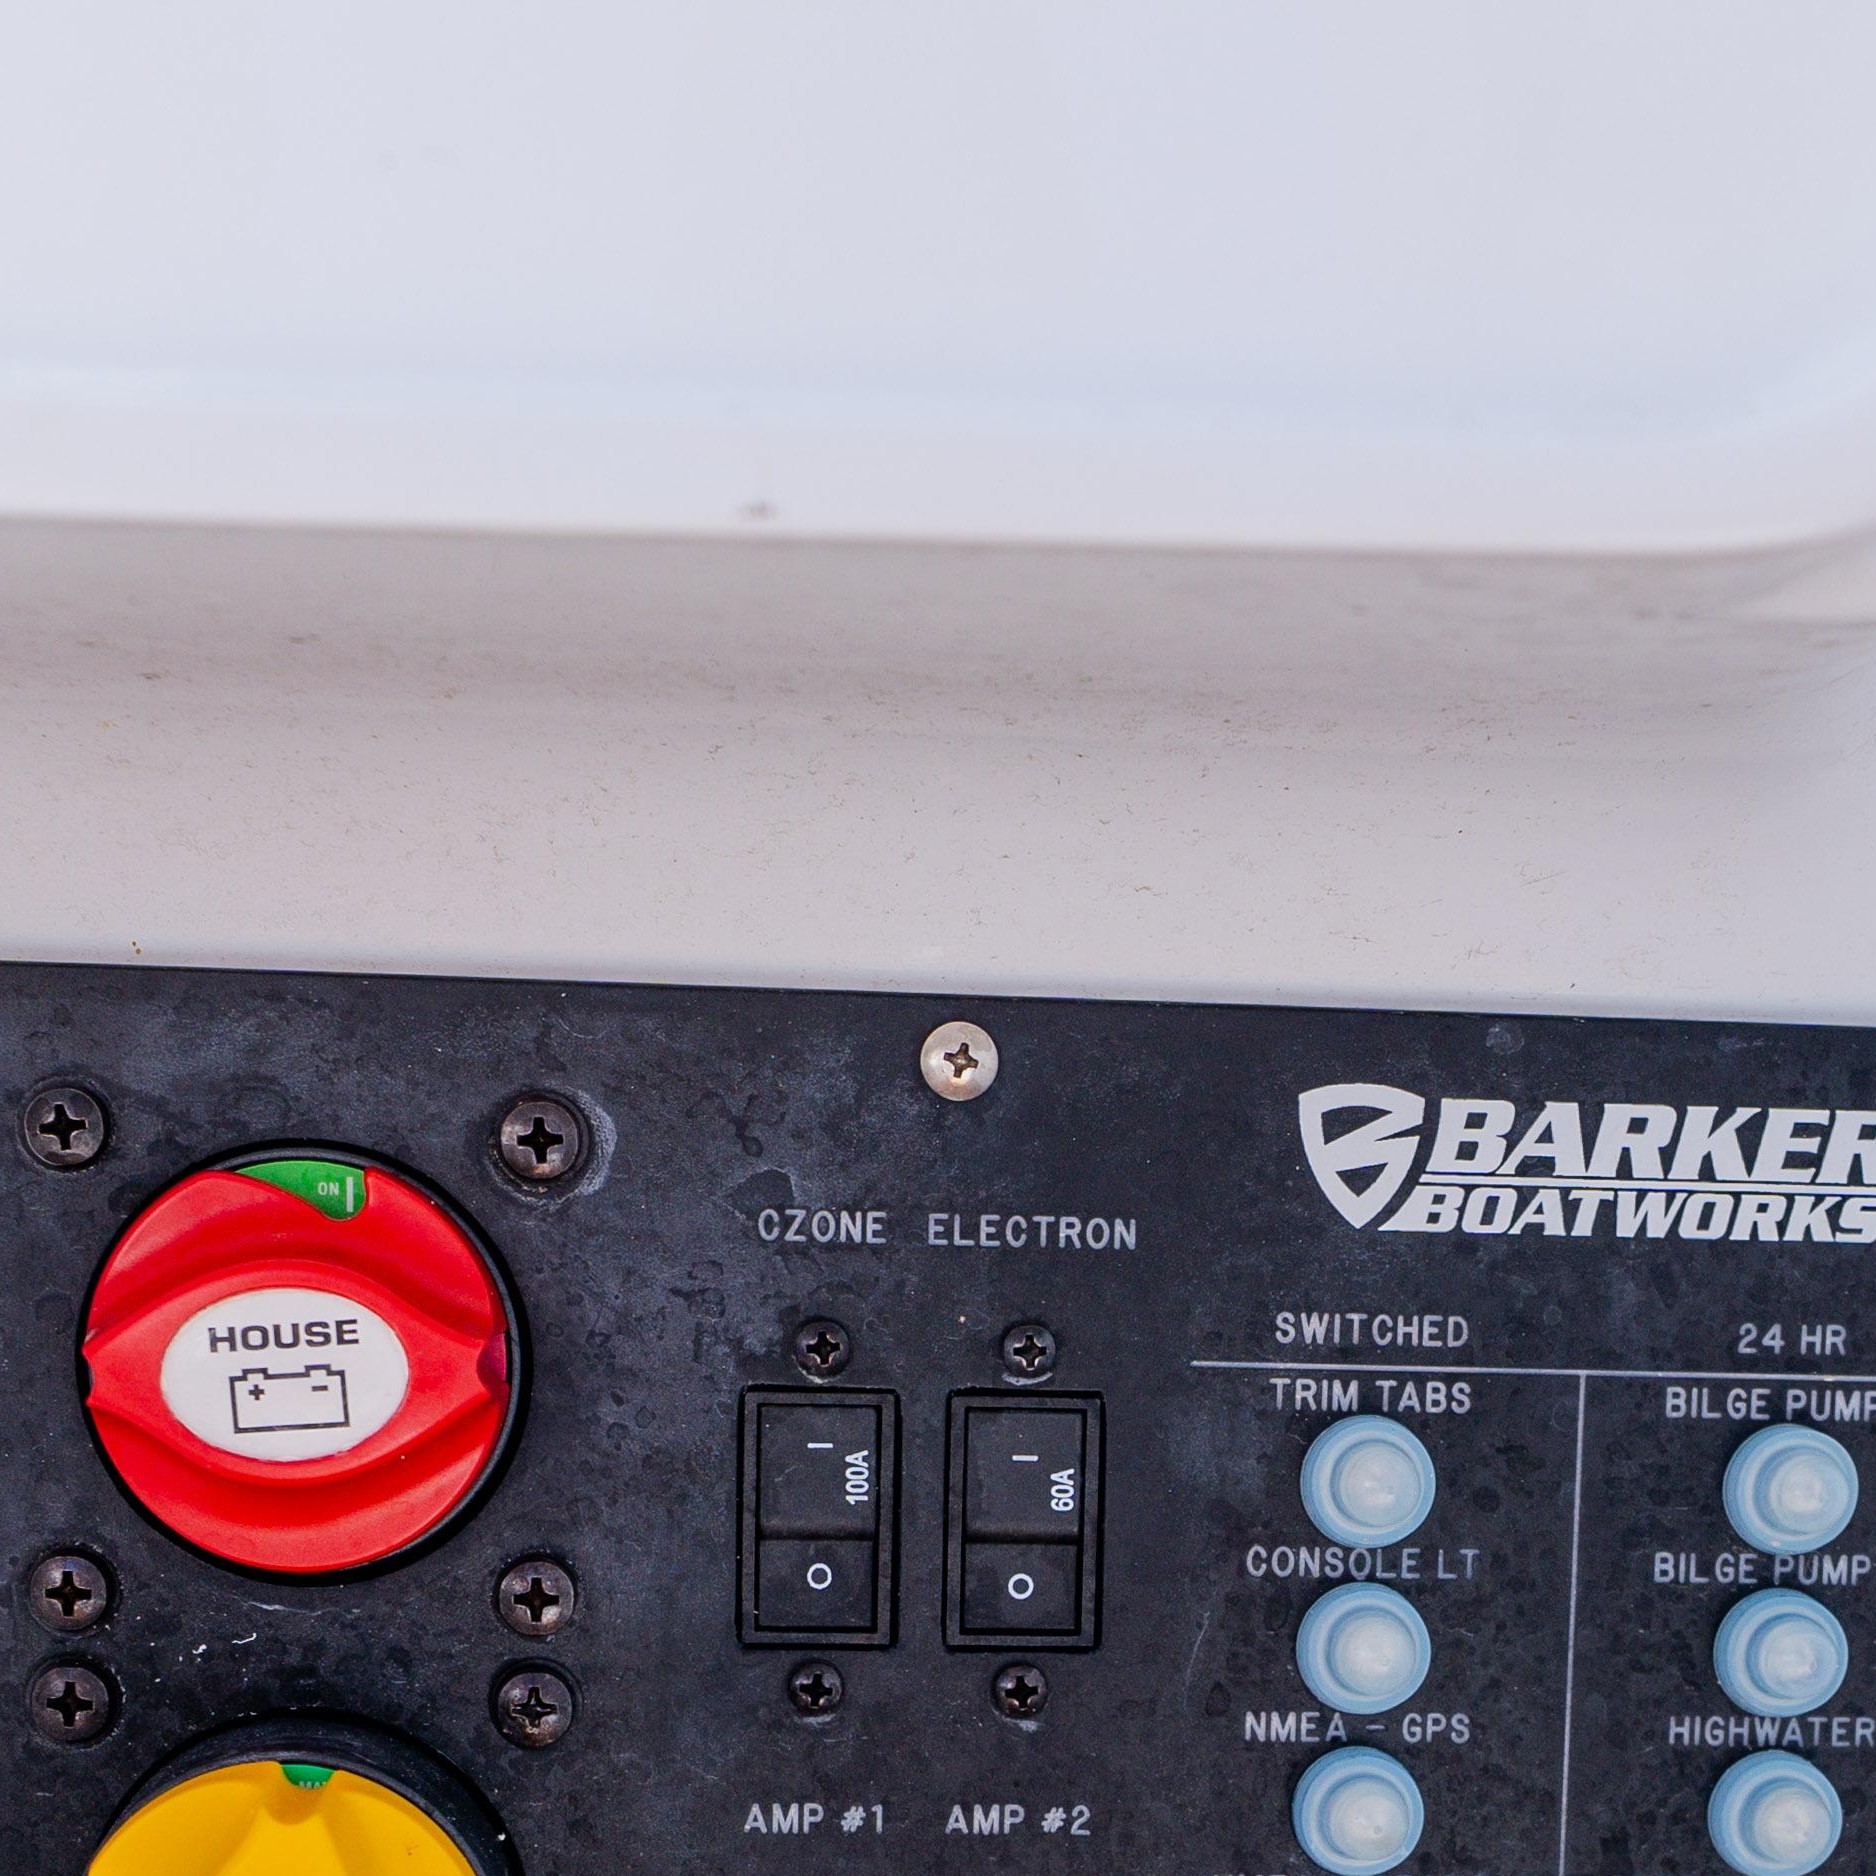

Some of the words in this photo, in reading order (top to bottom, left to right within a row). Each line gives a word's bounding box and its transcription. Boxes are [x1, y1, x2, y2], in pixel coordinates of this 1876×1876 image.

[318, 1182, 339, 1196] ON
[757, 1209, 888, 1244] CZONE
[927, 1213, 1137, 1250] ELECTRON
[208, 1319, 359, 1352] HOUSE
[1275, 1311, 1469, 1347] SWITCHED
[1736, 1322, 1786, 1355] 24
[1800, 1323, 1848, 1356] HR
[1269, 1378, 1359, 1412] TRIM
[1375, 1379, 1472, 1414] TABS
[1665, 1386, 1771, 1420] BILGE
[845, 1450, 869, 1505] 100A
[1050, 1468, 1075, 1511] 60A
[1246, 1545, 1422, 1580] CONSOLE
[1437, 1549, 1480, 1579] LT
[1653, 1551, 1758, 1584] BILGE
[1773, 1554, 1872, 1586] PUMP
[1244, 1711, 1348, 1743] NMEA
[1401, 1713, 1471, 1744] GPS
[1668, 1715, 1876, 1748] HIGHWATER
[743, 1803, 825, 1834] AMP
[840, 1804, 885, 1834] #1
[945, 1804, 1025, 1835] AMP
[1040, 1805, 1092, 1836] #2
